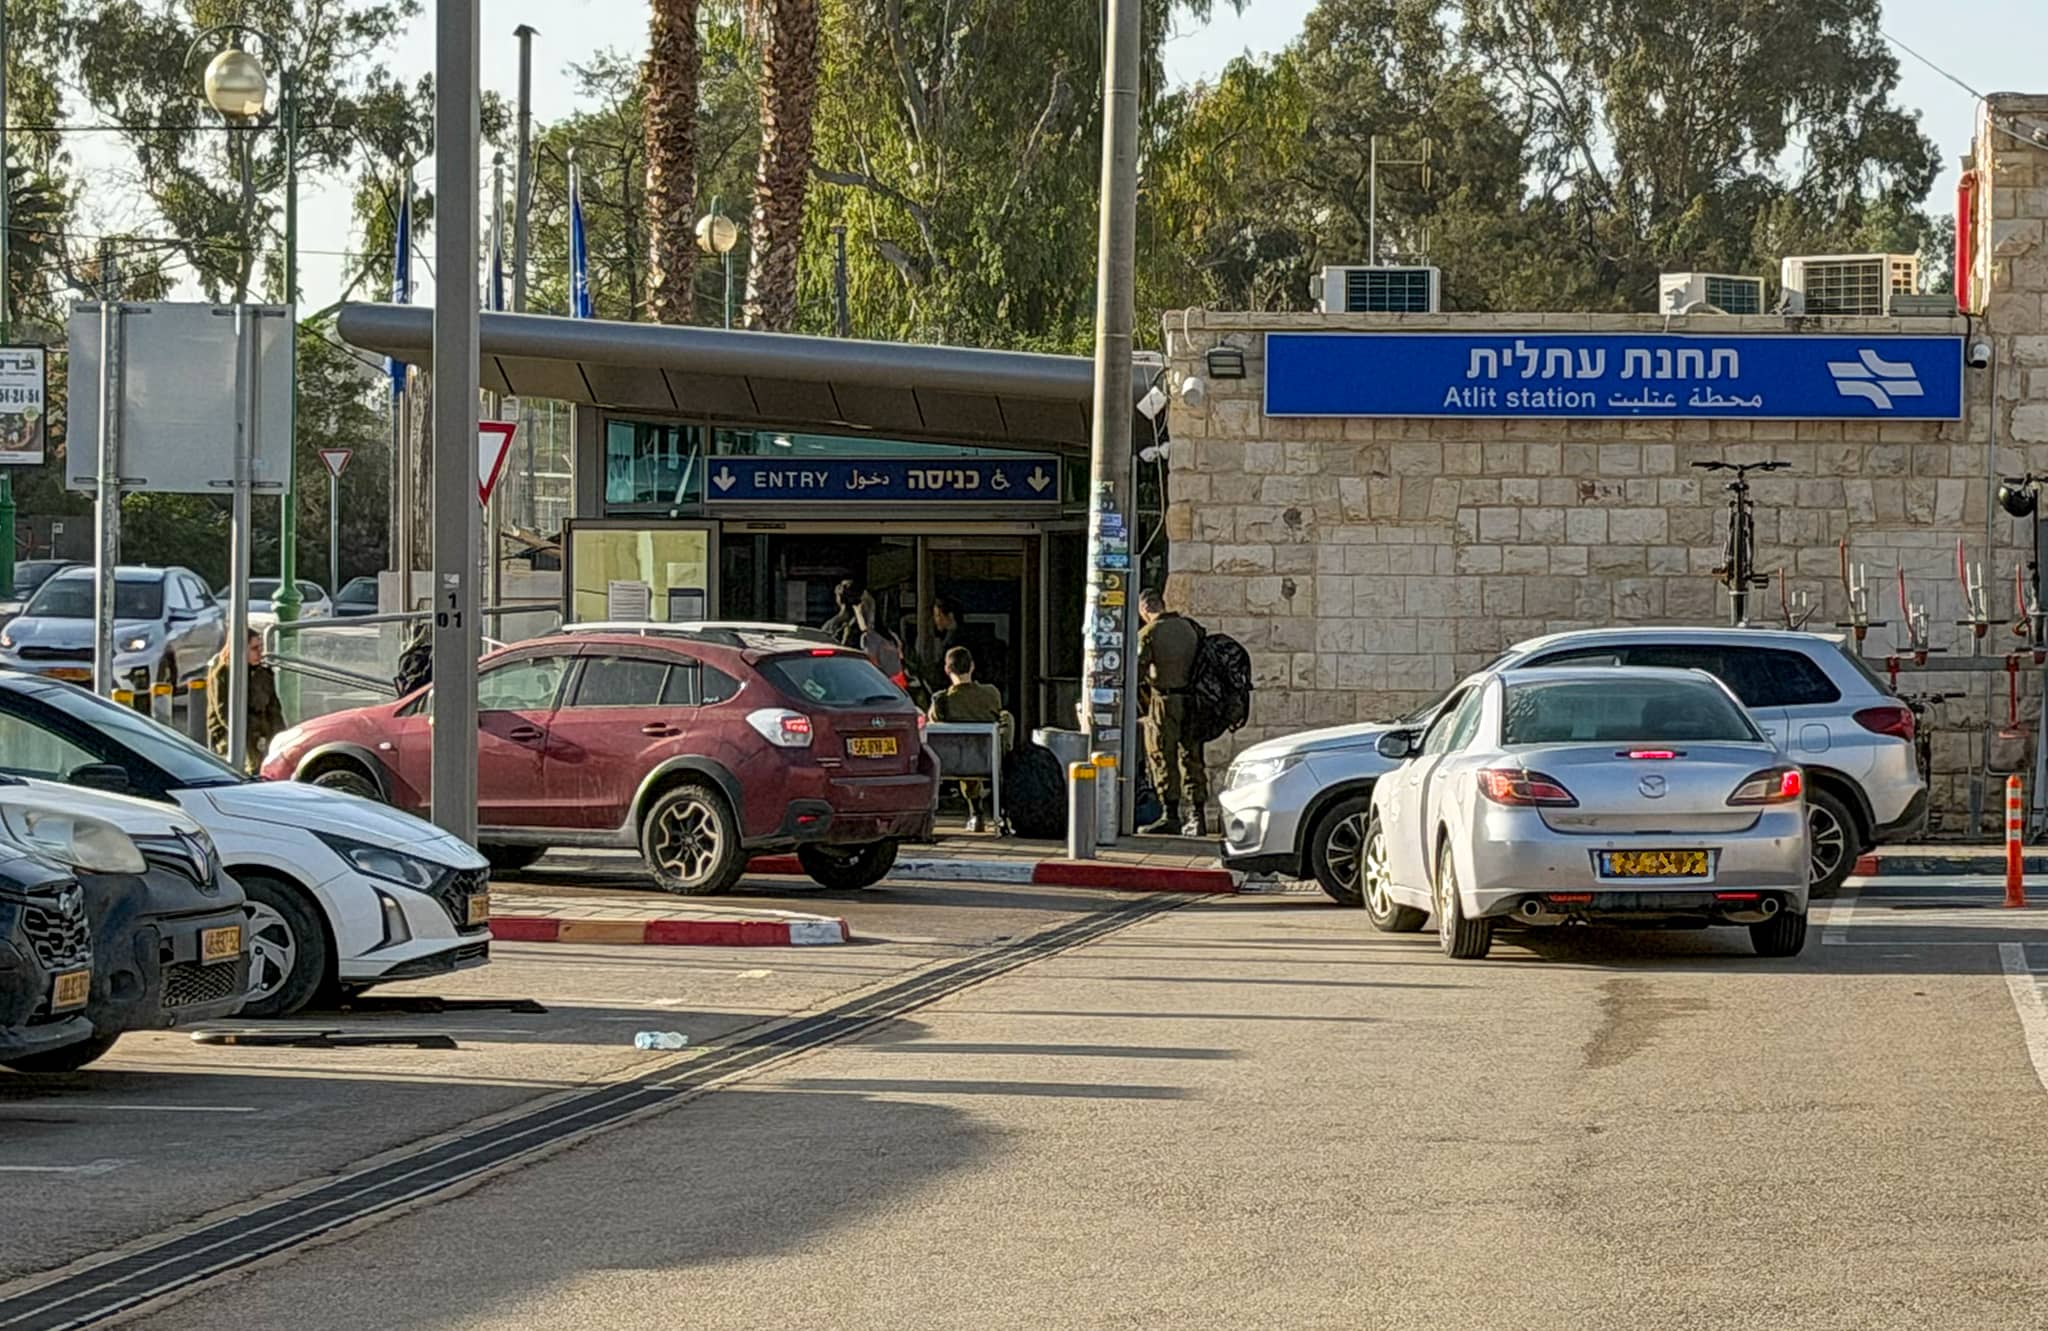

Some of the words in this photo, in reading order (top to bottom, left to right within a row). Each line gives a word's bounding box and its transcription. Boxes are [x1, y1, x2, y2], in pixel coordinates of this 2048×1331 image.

[1466, 340, 1606, 379] עתלית
[1620, 349, 1739, 379] תחנת
[1443, 387, 1497, 408] Atlit
[1506, 387, 1596, 408] station
[1607, 387, 1677, 413] عتليت
[1688, 386, 1763, 408] محطة
[754, 471, 829, 488] ENTRY
[845, 470, 890, 490] دخول
[907, 470, 980, 489] כניסה
[448, 592, 456, 609] 1
